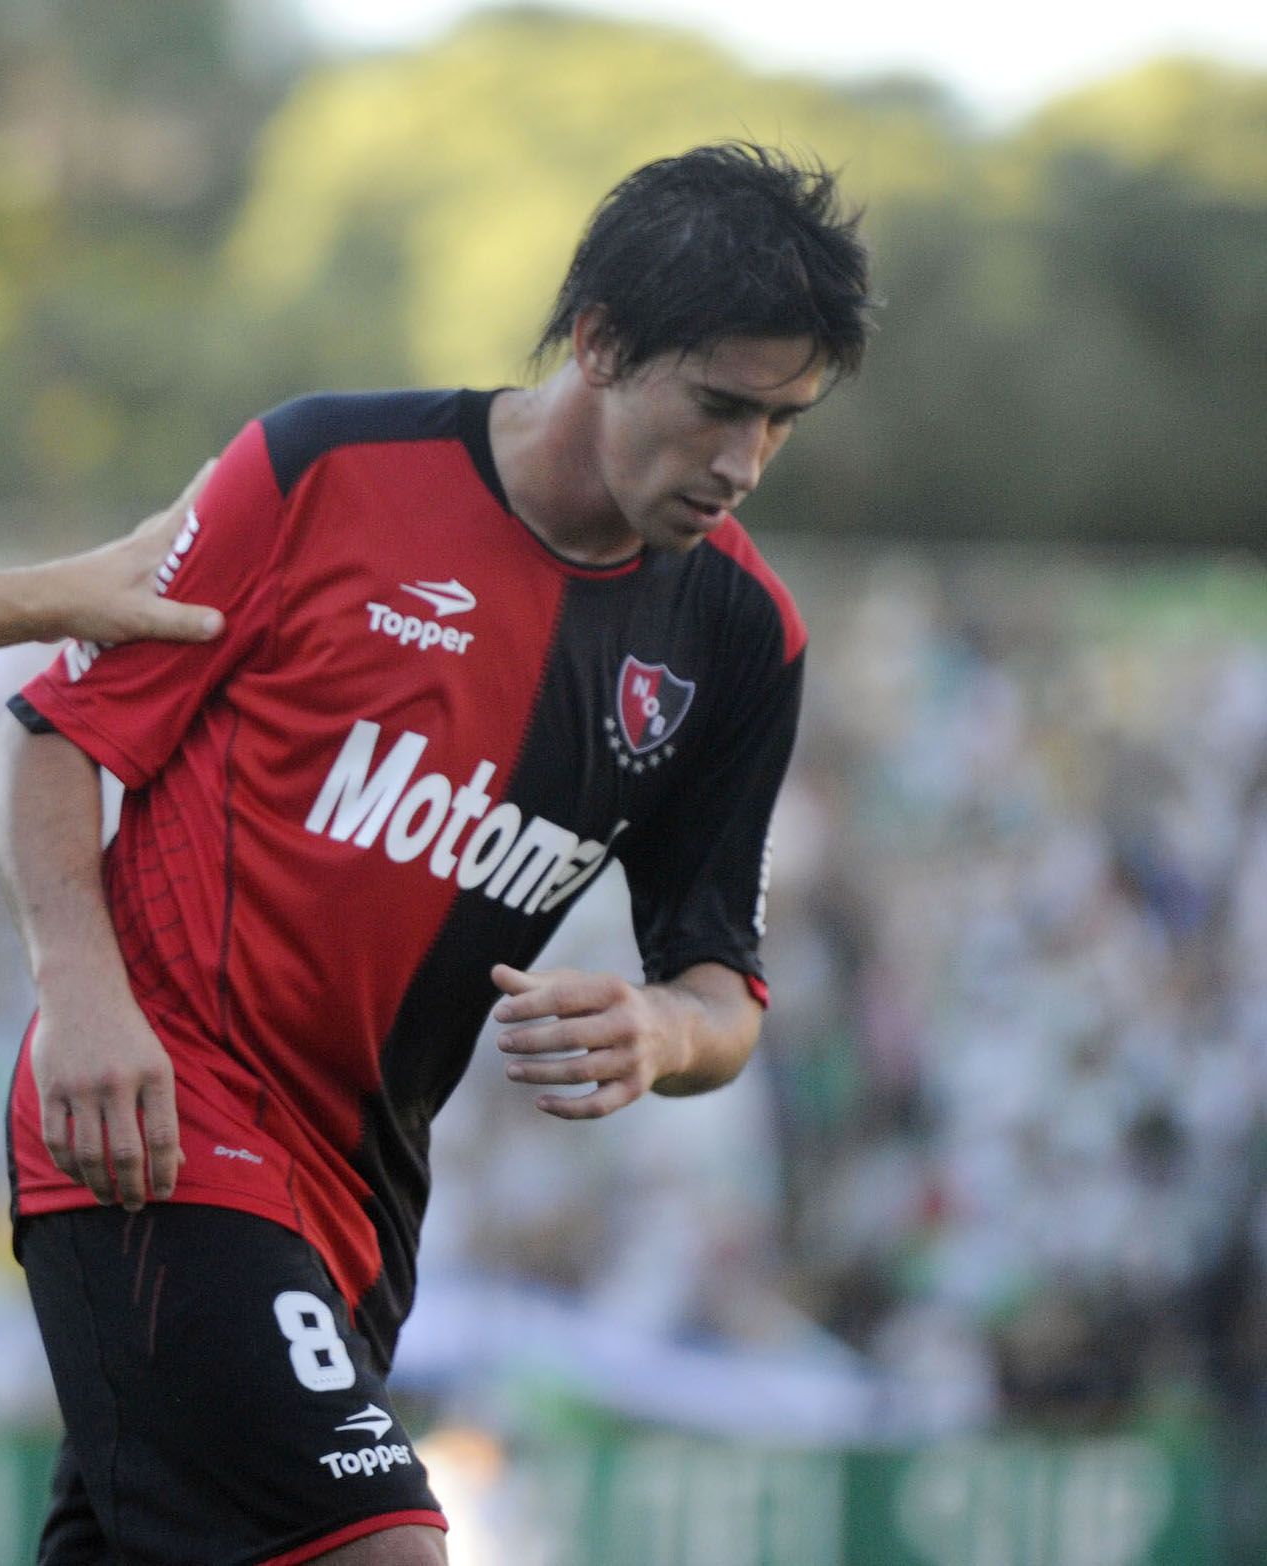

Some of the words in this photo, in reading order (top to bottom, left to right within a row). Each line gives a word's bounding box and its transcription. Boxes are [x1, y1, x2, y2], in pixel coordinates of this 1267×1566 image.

[366, 601, 475, 655] Topper
[304, 719, 630, 917] Motoma
[273, 1290, 357, 1392] 8
[319, 1444, 413, 1479] Topper
